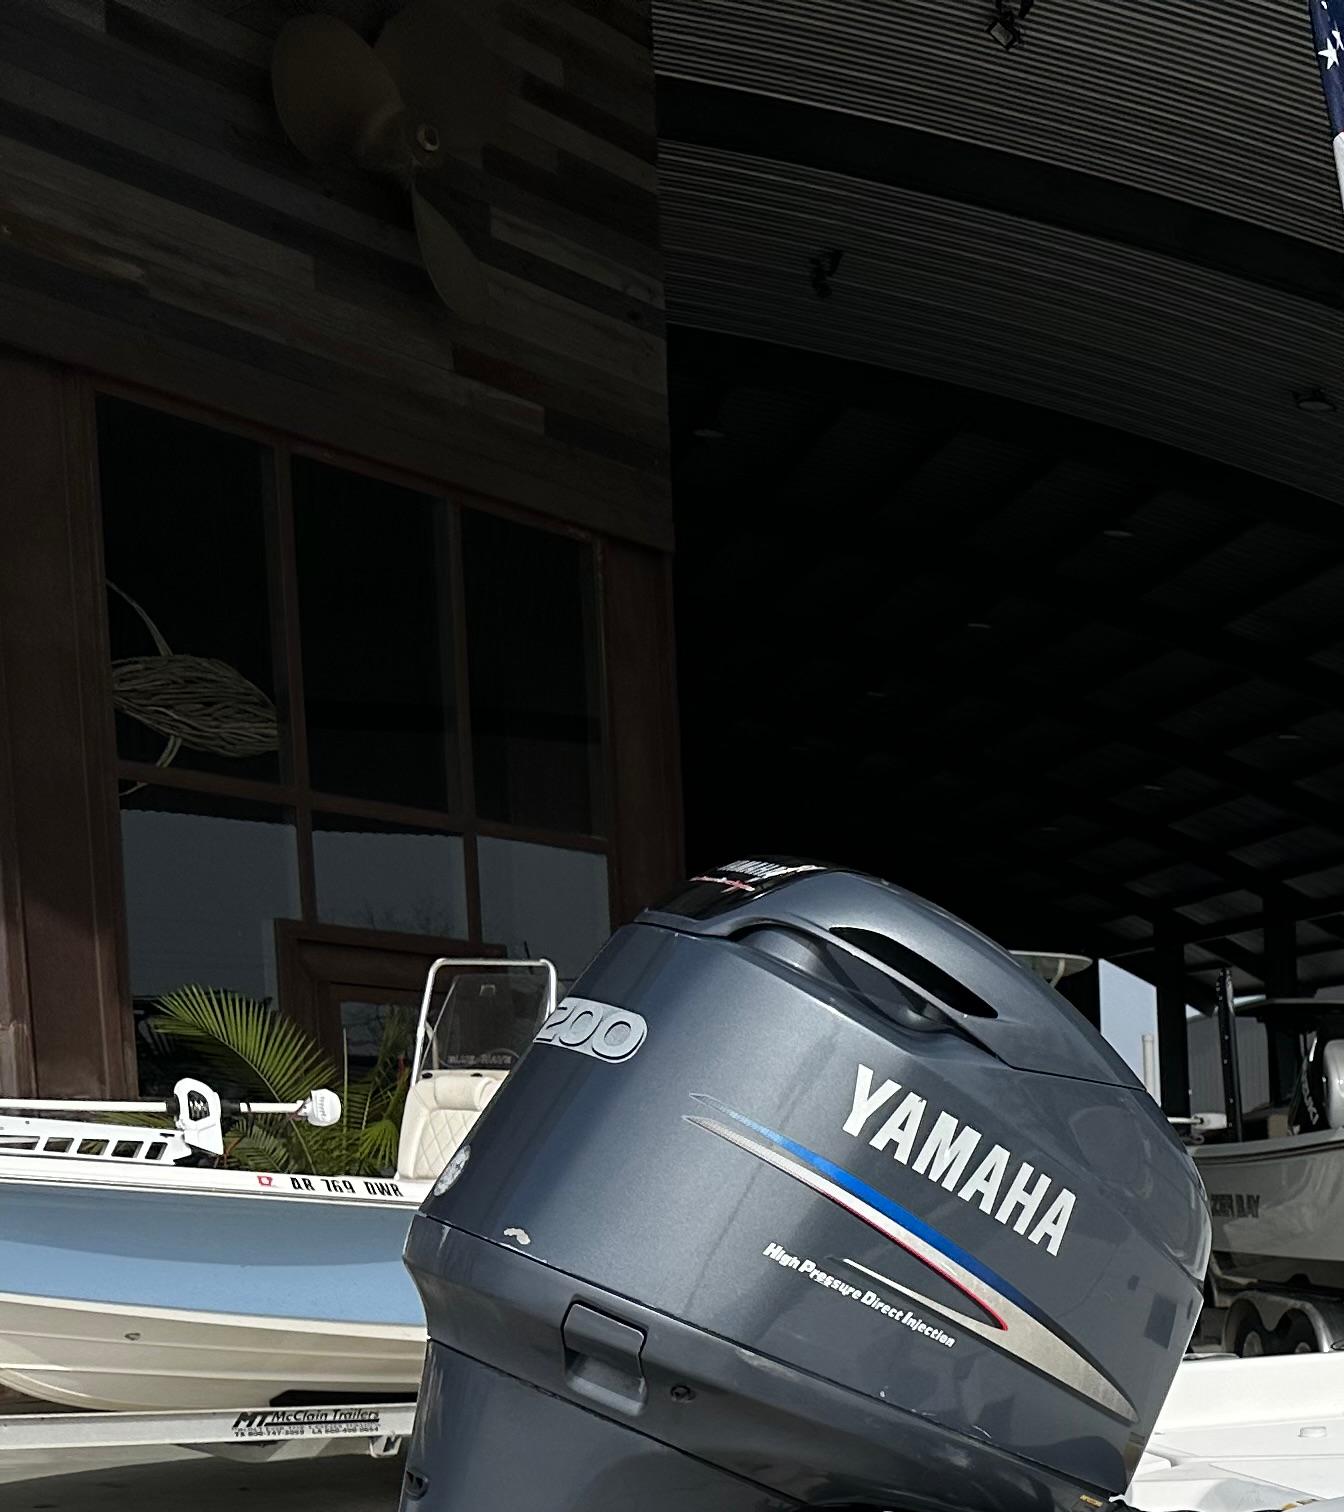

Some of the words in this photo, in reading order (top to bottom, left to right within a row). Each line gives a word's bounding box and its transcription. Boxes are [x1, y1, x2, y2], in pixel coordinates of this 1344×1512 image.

[535, 1003, 646, 1061] 200
[321, 1178, 356, 1194] 769
[842, 1063, 1077, 1257] YAMAHA
[762, 1242, 800, 1270] High
[799, 1259, 862, 1300] Pressure
[860, 1290, 904, 1321] Direct
[901, 1311, 956, 1347] Injection
[271, 1411, 328, 1422] McClain
[332, 1408, 379, 1420] Trailers
